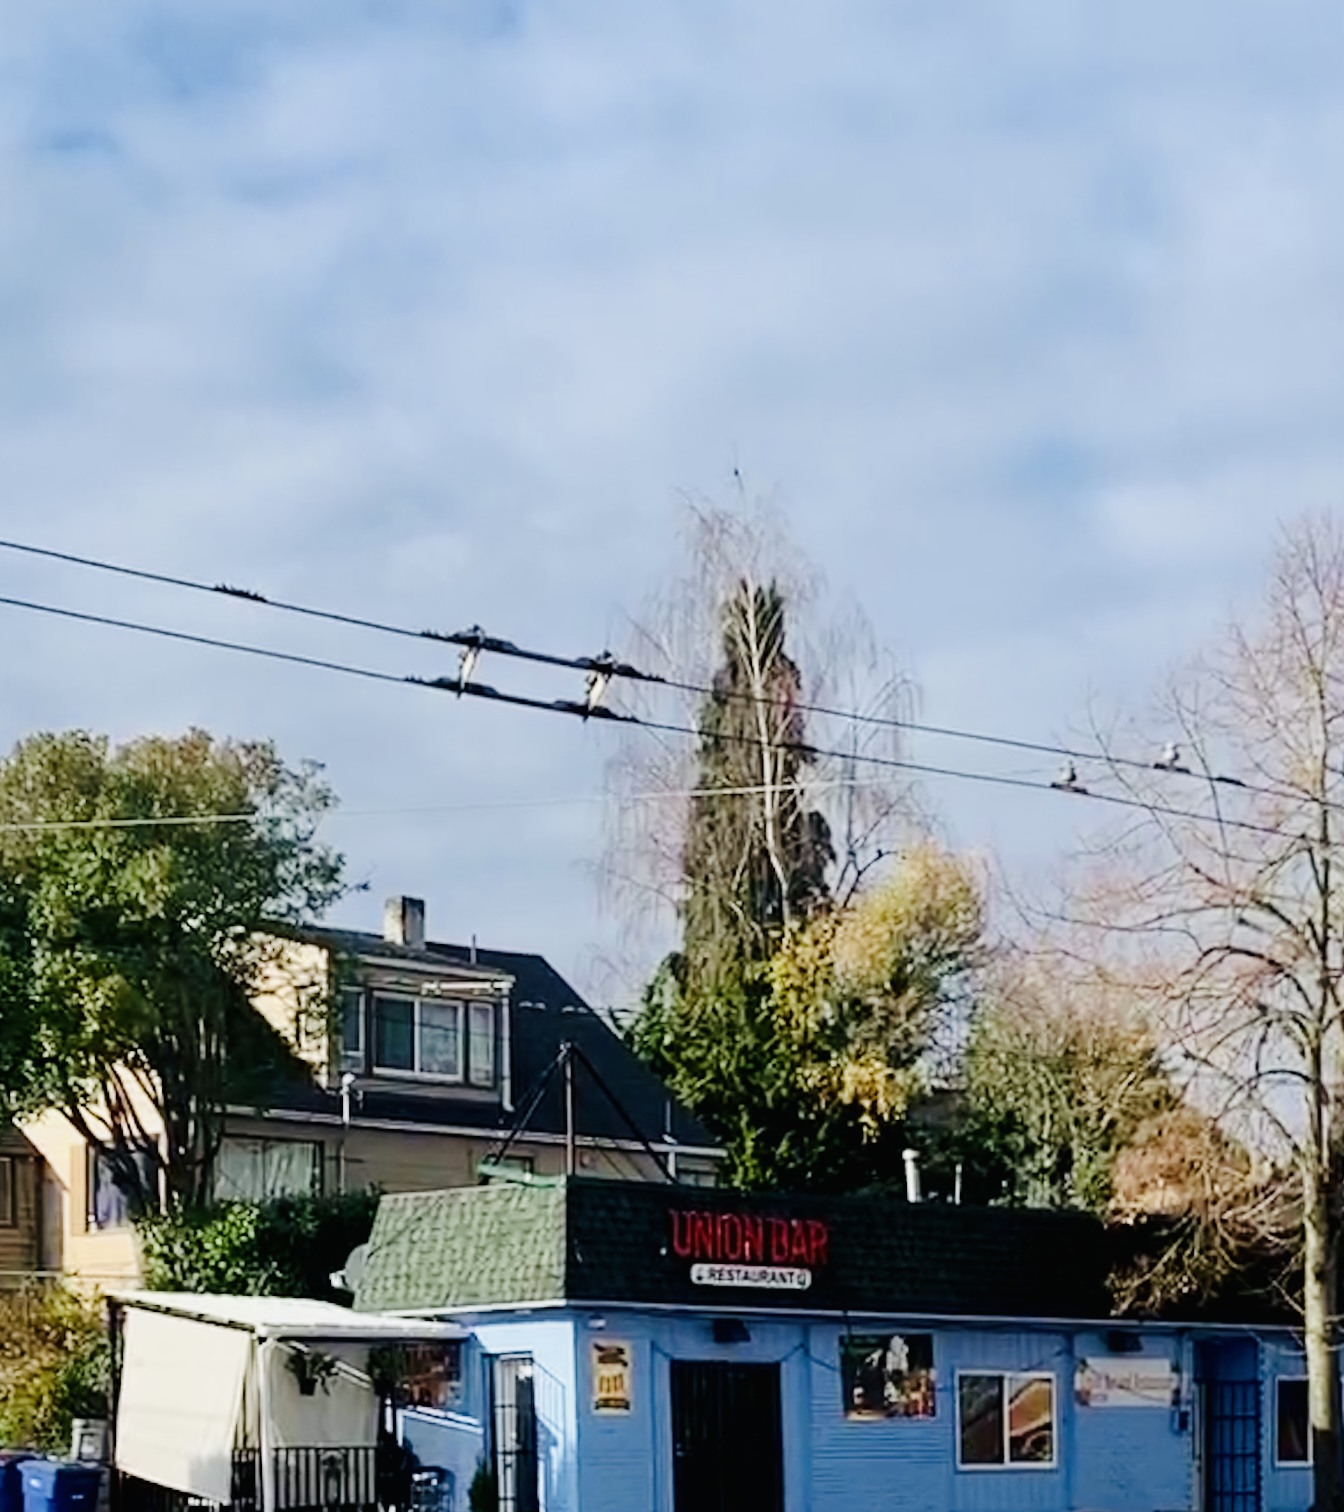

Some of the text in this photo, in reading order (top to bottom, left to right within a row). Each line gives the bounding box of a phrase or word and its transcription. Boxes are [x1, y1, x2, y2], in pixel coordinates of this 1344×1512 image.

[669, 1208, 828, 1265] UNION BAR
[708, 1267, 795, 1284] RESTAURANT
